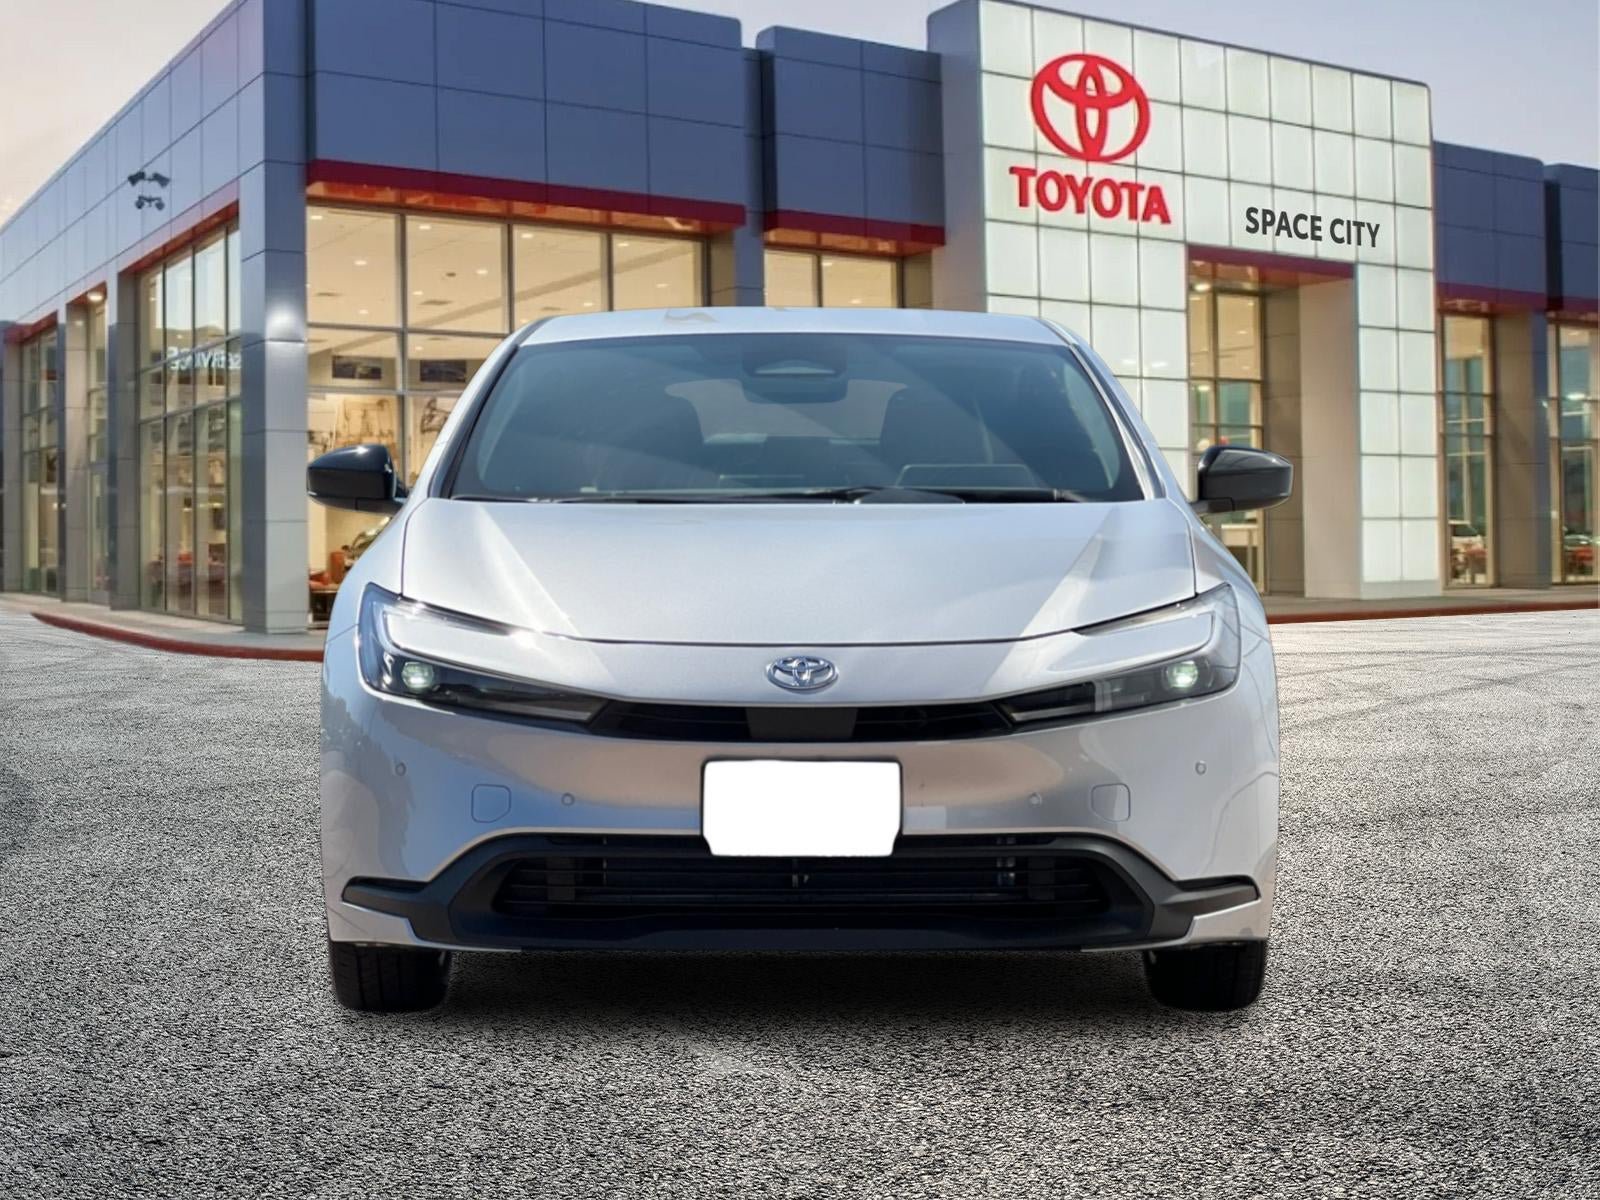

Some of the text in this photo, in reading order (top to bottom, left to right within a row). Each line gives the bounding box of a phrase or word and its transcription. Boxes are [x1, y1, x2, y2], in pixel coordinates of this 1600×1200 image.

[1009, 166, 1171, 225] TOYOTA
[1245, 206, 1381, 248] SPACE CITY
